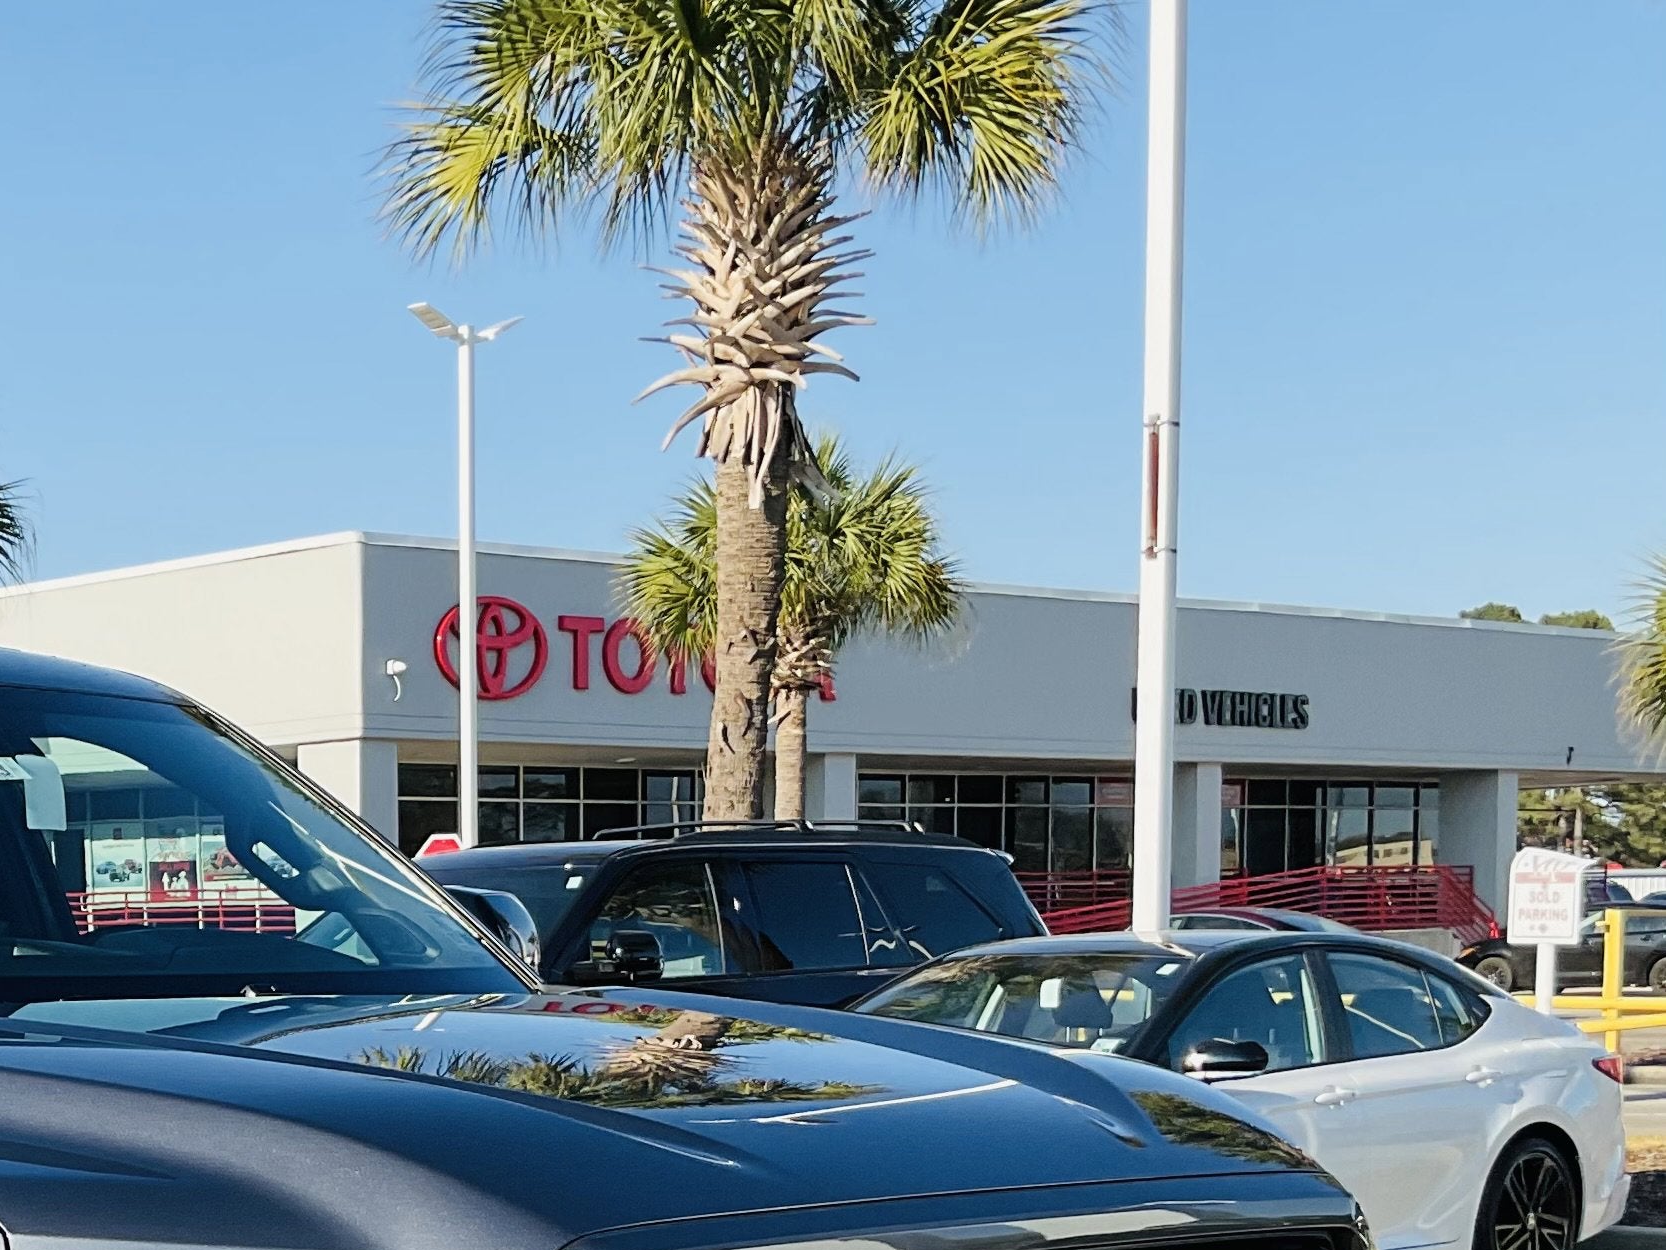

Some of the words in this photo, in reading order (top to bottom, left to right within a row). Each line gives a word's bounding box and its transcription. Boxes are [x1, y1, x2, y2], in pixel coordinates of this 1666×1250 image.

[1201, 690, 1310, 729] VEHICLES
[1529, 891, 1559, 903] SOLD
[1518, 908, 1568, 921] PARKING
